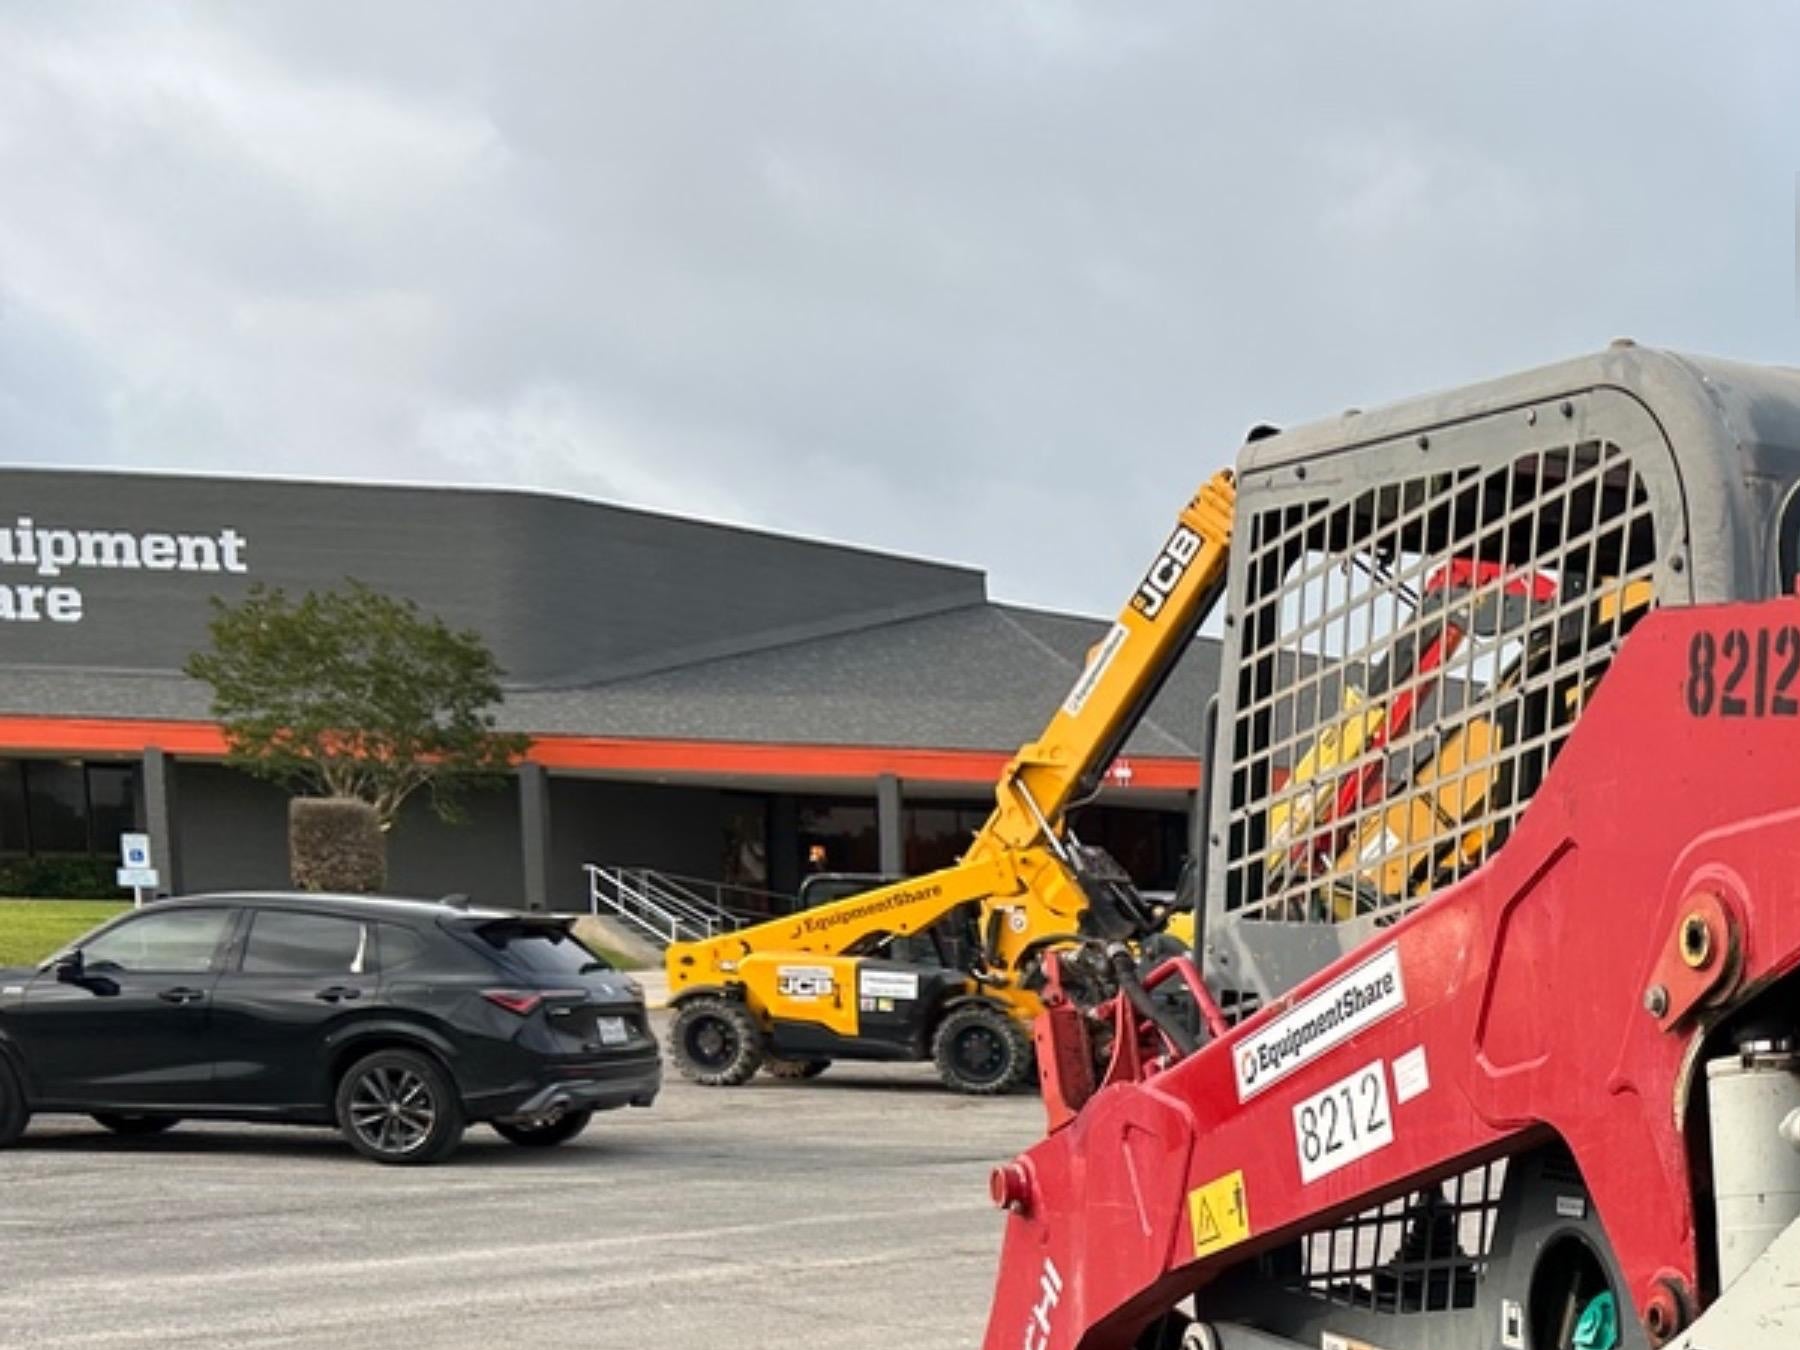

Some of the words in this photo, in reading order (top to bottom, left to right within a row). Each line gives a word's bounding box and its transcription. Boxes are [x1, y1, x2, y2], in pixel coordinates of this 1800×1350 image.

[1141, 525, 1203, 618] JCB
[1256, 971, 1394, 1074] EquipmentShare
[1300, 1072, 1386, 1162] 8212
